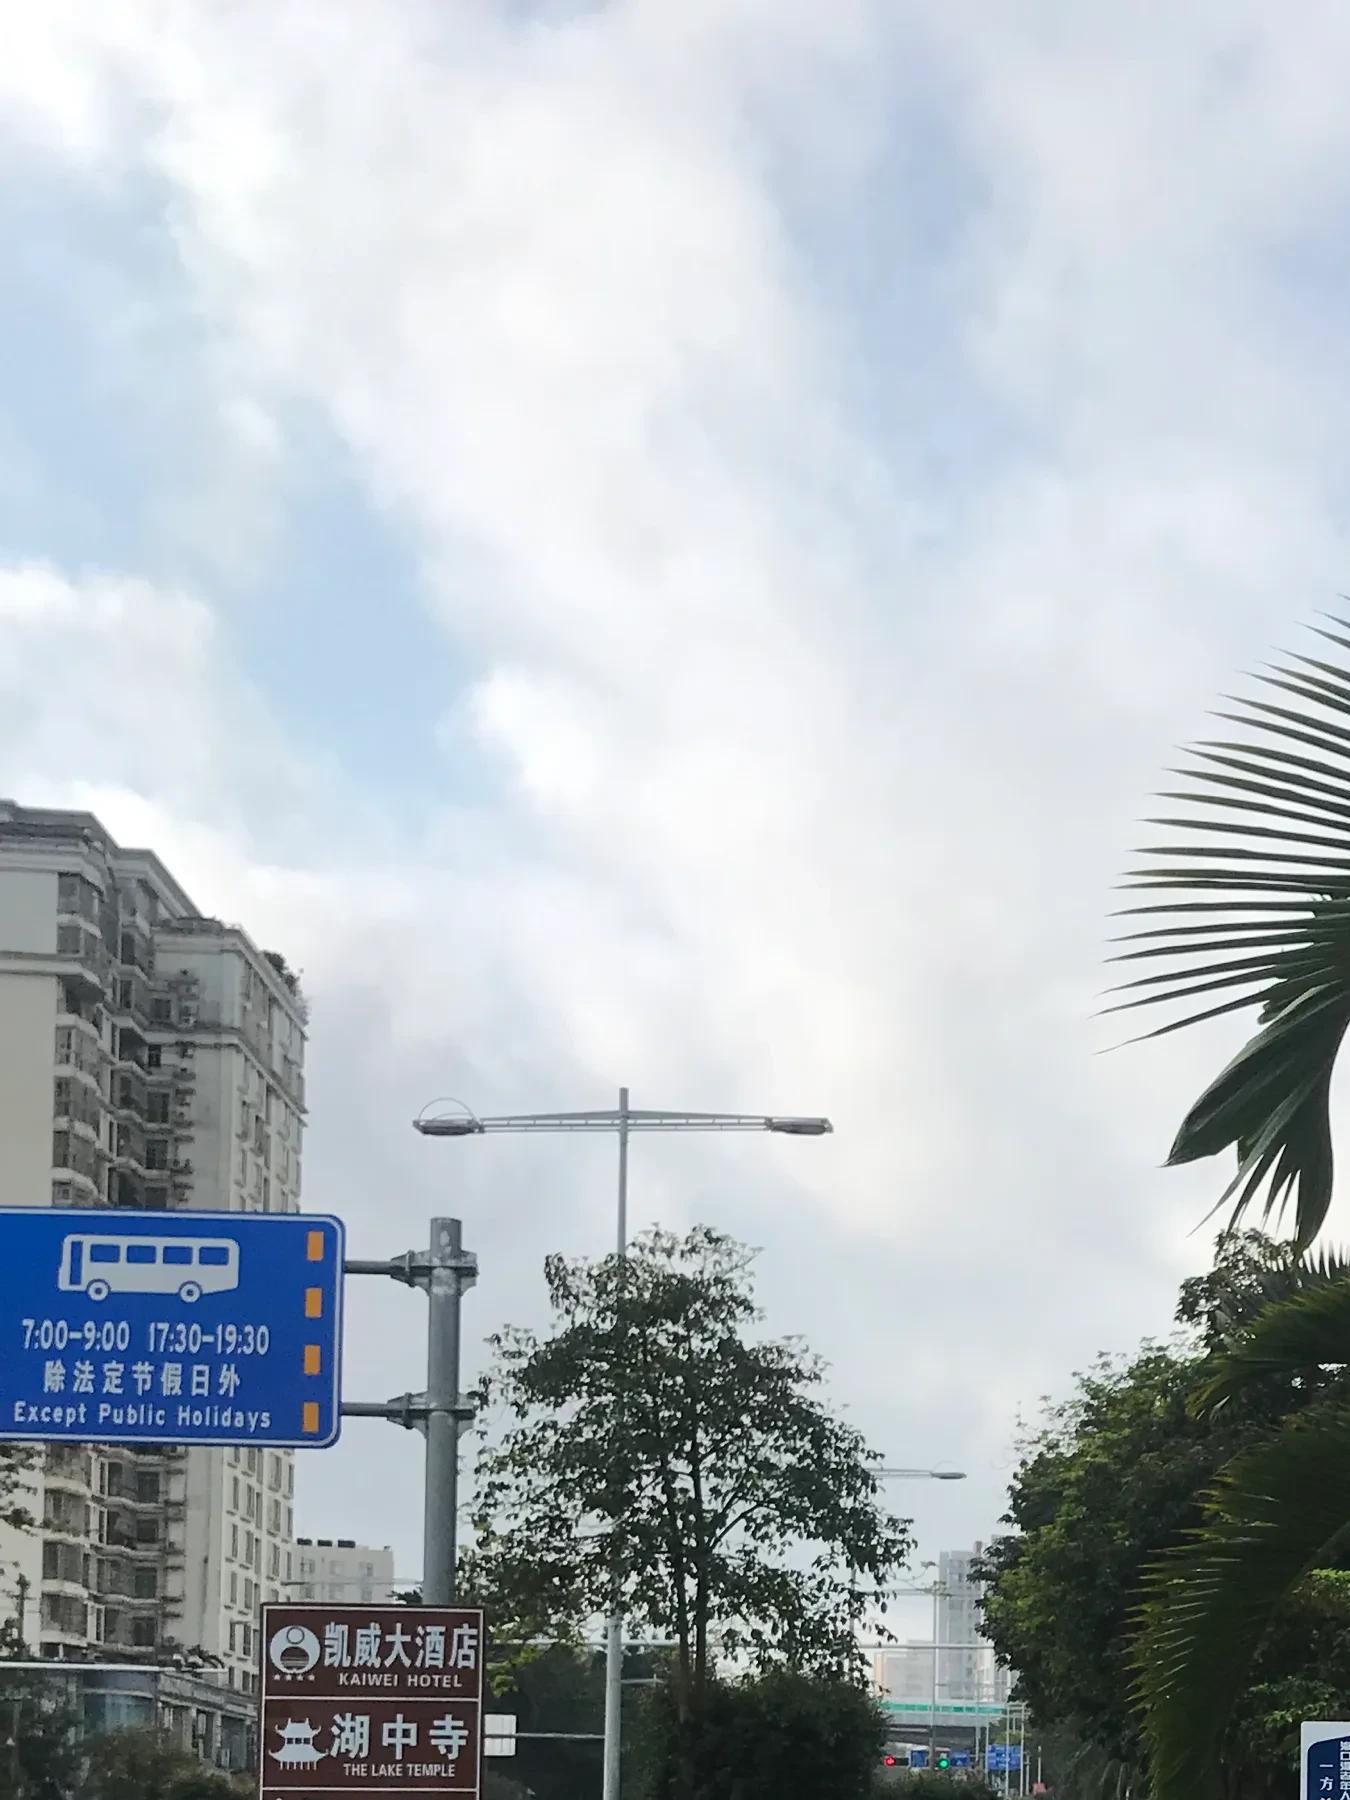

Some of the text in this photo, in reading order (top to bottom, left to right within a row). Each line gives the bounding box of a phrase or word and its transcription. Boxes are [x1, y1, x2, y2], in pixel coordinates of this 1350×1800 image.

[22, 1318, 270, 1355] 7:00-9:00 17:30-19:30
[43, 1358, 241, 1397] 除法定节假日外
[14, 1400, 272, 1432] Except Public Holidays
[324, 1621, 479, 1670] 凯威大酒店
[338, 1672, 463, 1688] KAIWEI HOTEL
[330, 1712, 469, 1760] 湖中寺
[343, 1763, 456, 1778] THE LAKE TEMPLE
